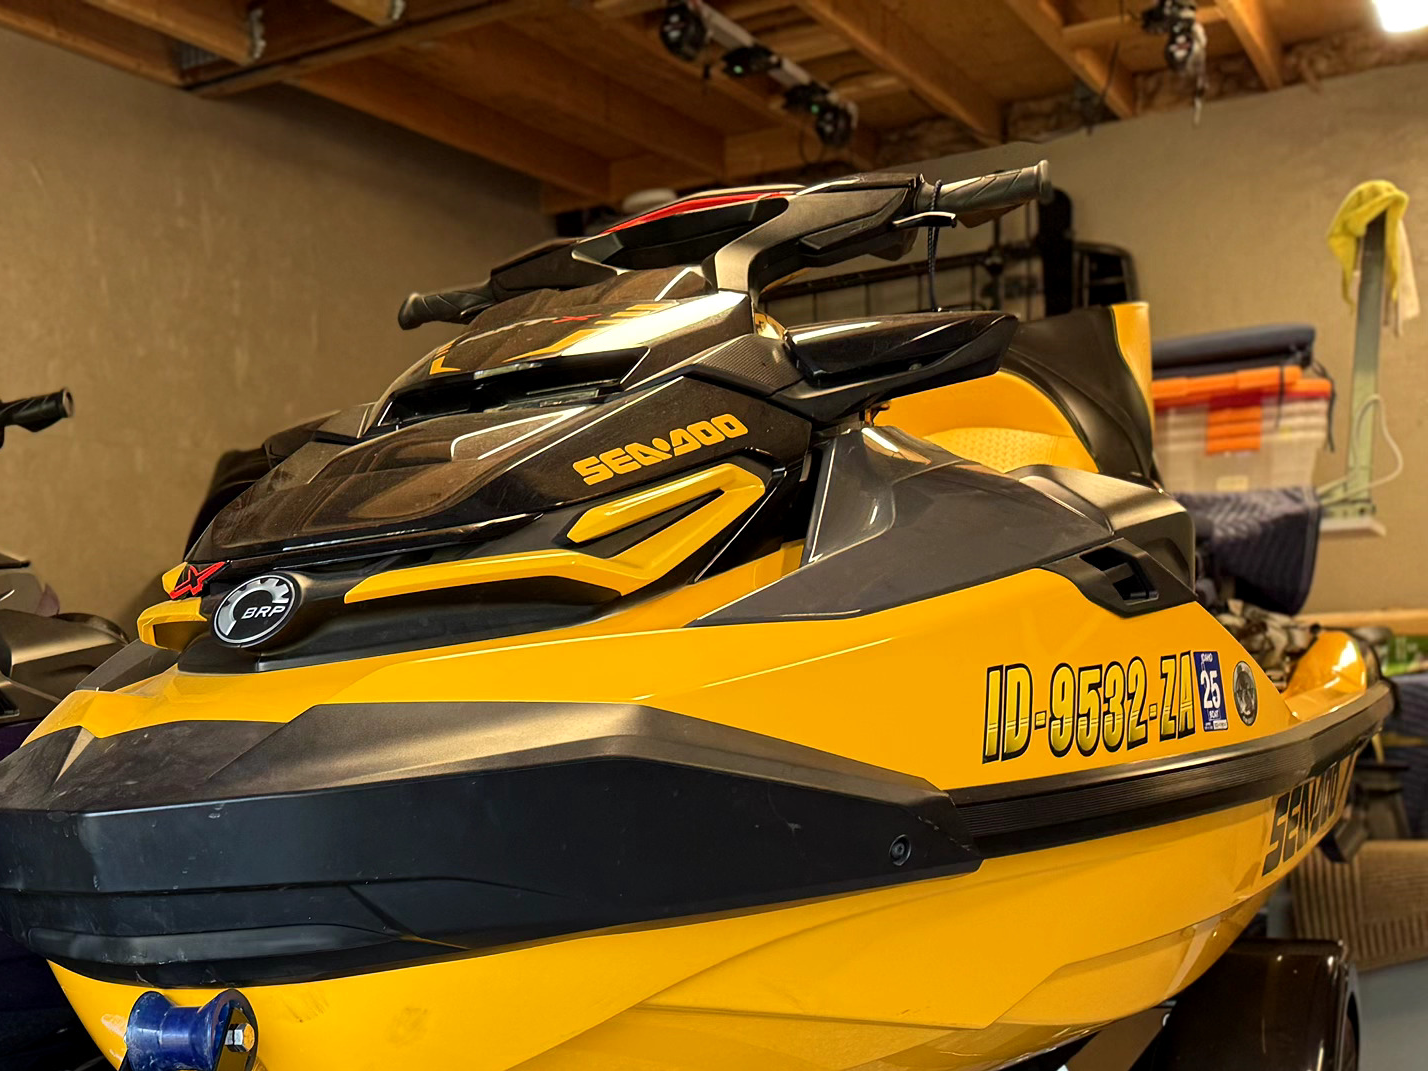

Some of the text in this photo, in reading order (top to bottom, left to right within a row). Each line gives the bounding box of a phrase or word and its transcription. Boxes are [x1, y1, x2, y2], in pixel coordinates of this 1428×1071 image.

[241, 605, 286, 619] BRP
[982, 650, 1196, 764] ID-9532-ZA
[1200, 670, 1221, 709] 25
